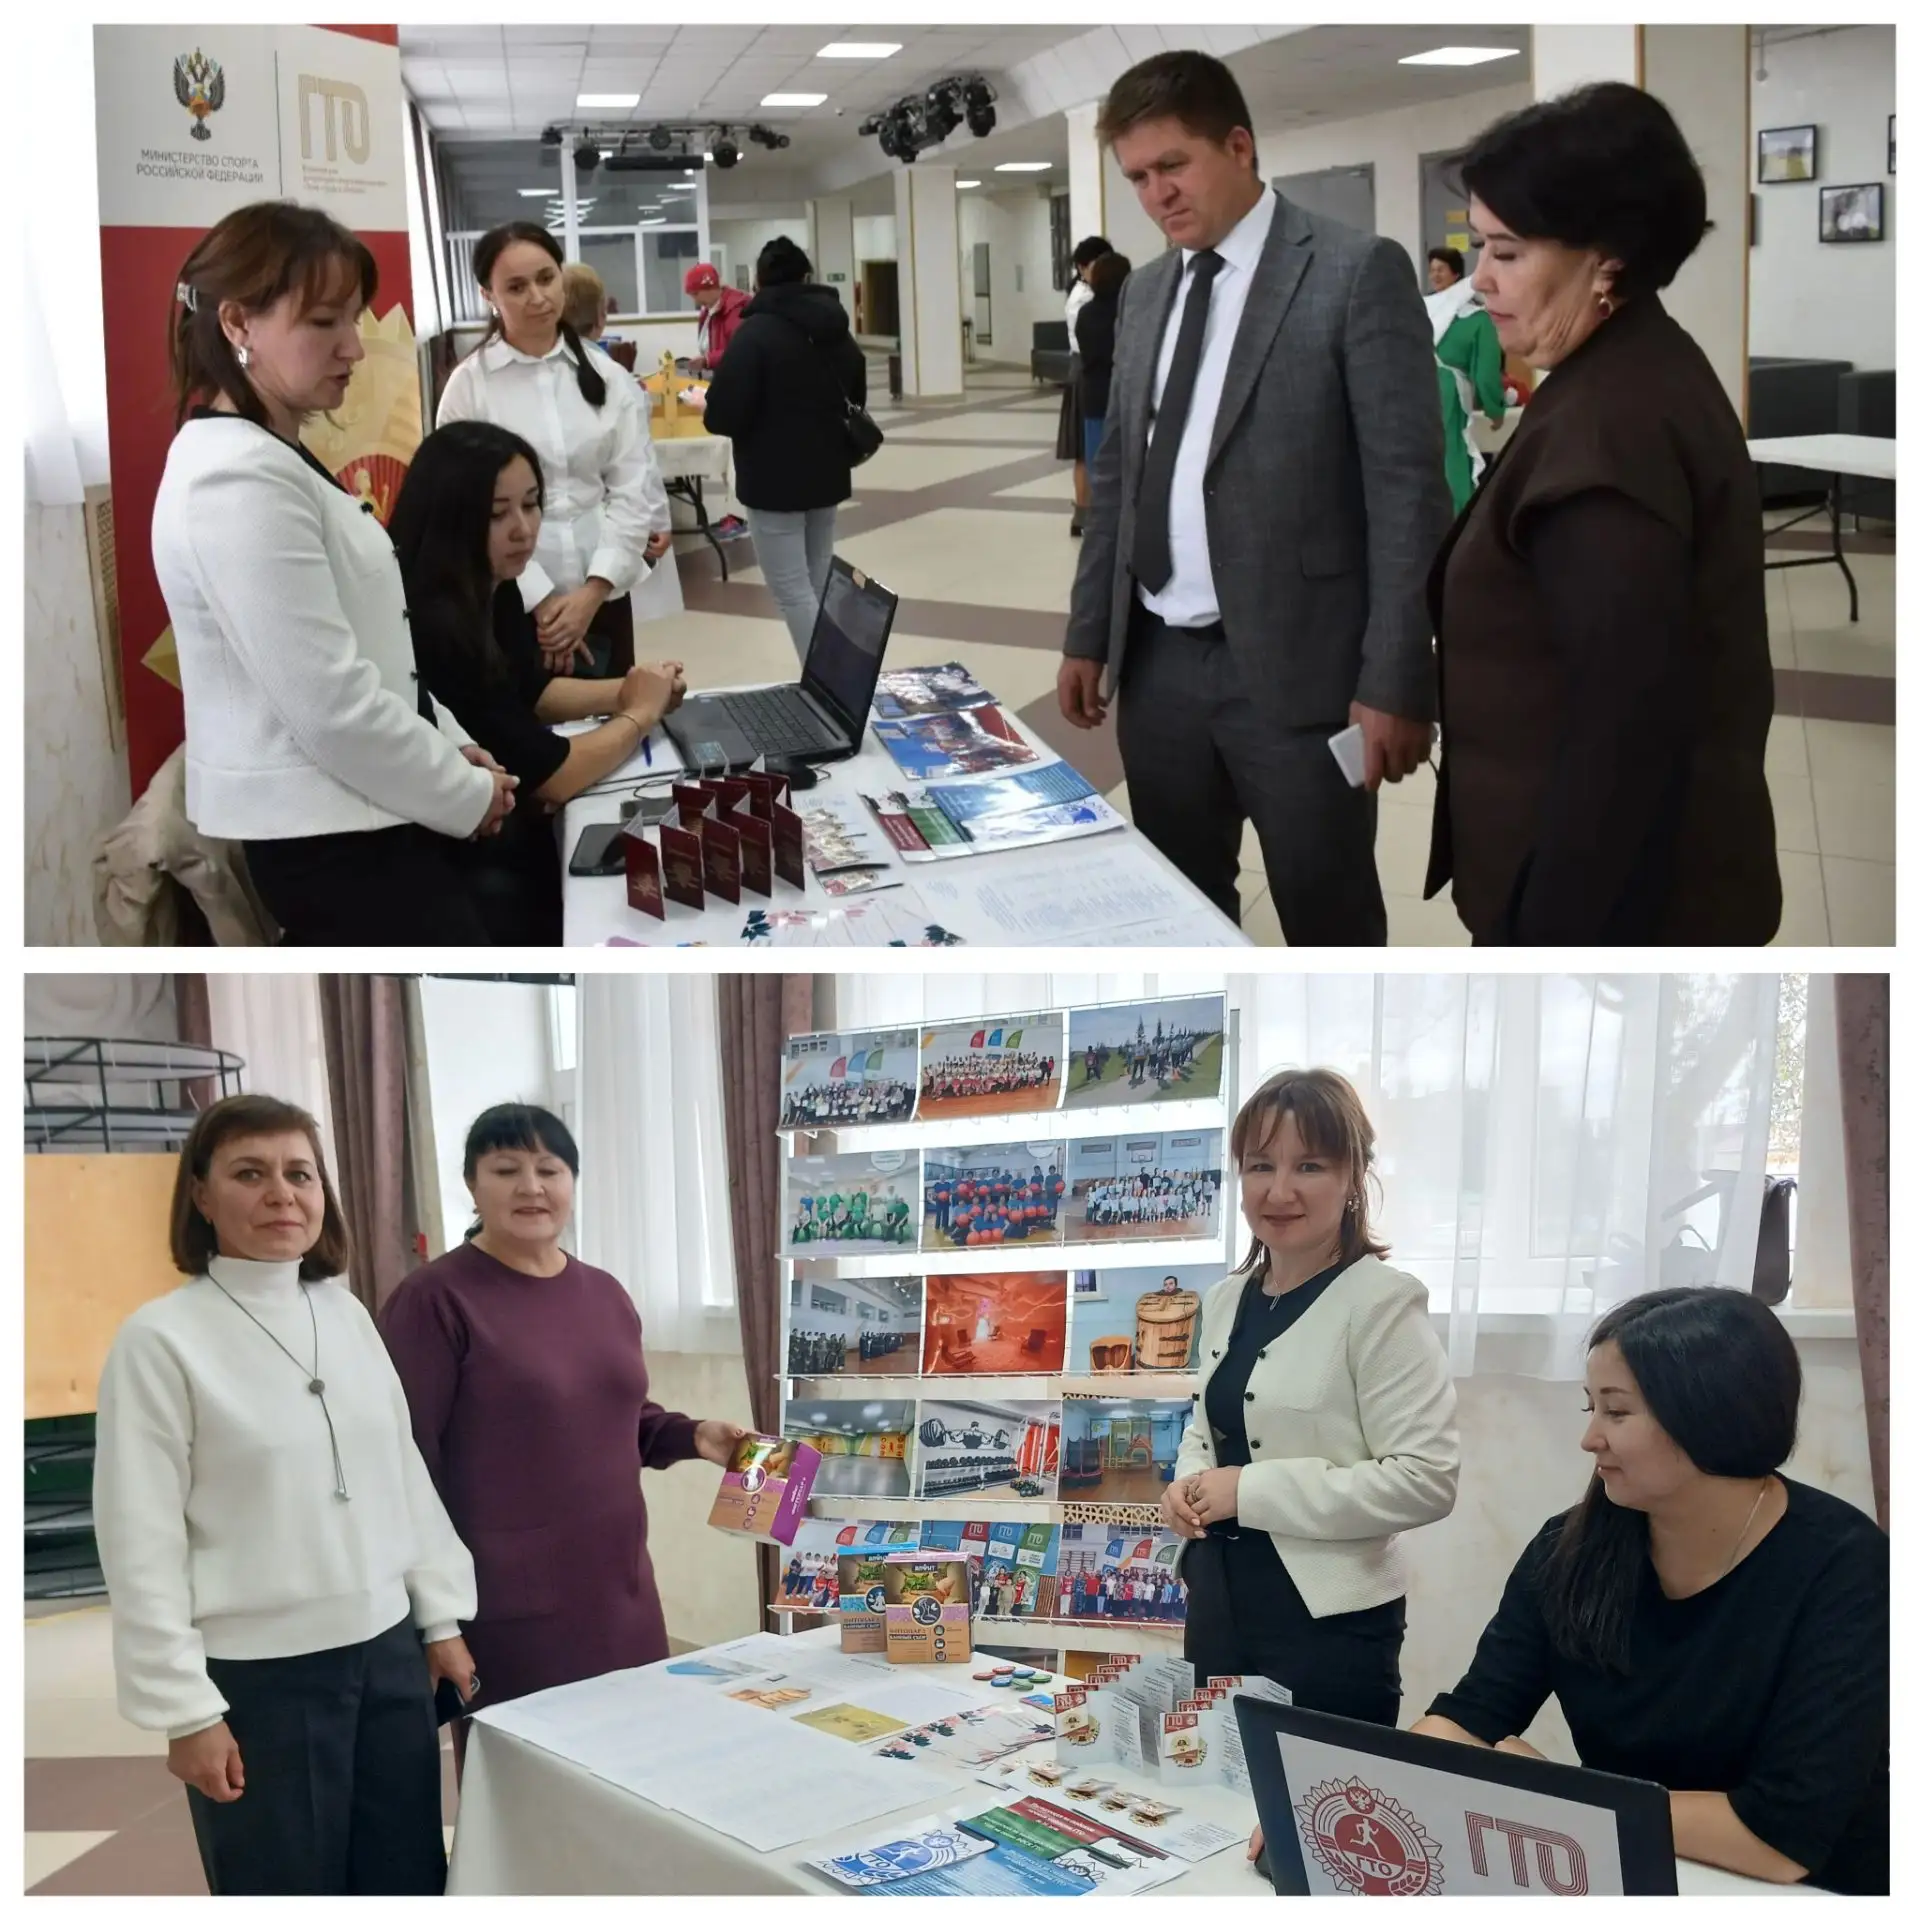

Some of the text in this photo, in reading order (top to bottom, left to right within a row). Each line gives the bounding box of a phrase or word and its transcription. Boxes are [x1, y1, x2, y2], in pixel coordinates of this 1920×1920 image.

[298, 74, 370, 165] ГТО
[141, 149, 259, 169] МИНИСТЕРСТВО СПОРТА
[136, 162, 264, 183] РОССИЙСКОЙ ФЕДЕРАЦИИ
[860, 1853, 891, 1868] ГТО
[1465, 1810, 1588, 1896] ГТО
[1356, 1855, 1392, 1876] ГТО
